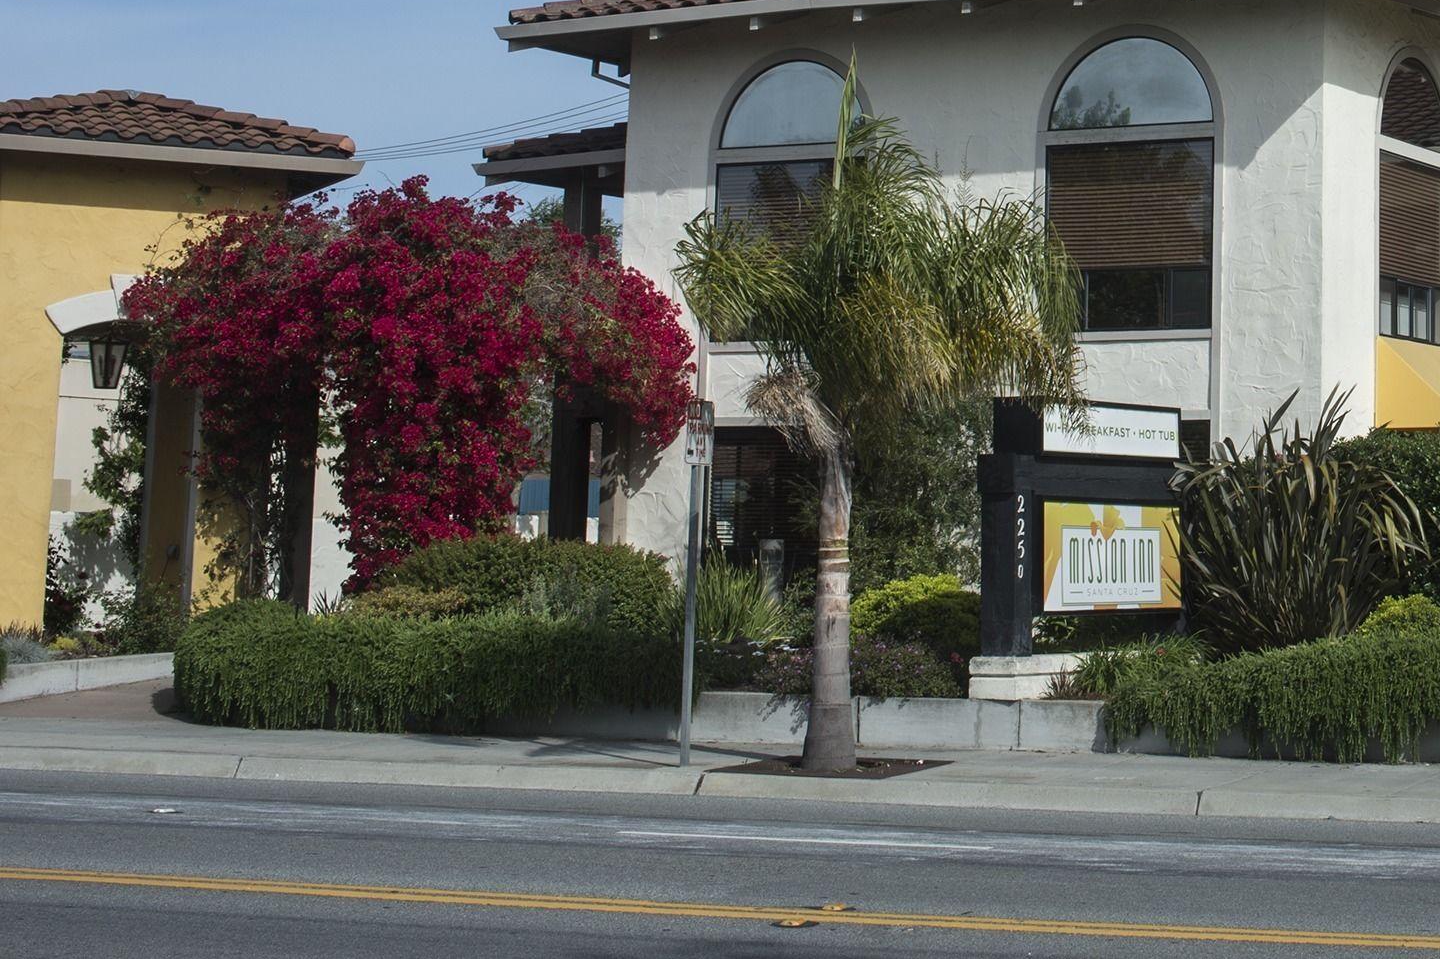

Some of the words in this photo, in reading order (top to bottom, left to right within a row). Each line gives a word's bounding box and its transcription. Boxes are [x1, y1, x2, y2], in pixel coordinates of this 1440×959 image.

[1139, 429, 1156, 439] HOT
[1159, 430, 1175, 441] TUB
[1017, 494, 1025, 579] 2250
[1069, 537, 1127, 584] MISSION
[1132, 538, 1154, 583] INN
[1086, 587, 1113, 596] SANTA
[1117, 587, 1139, 596] CRUZ
